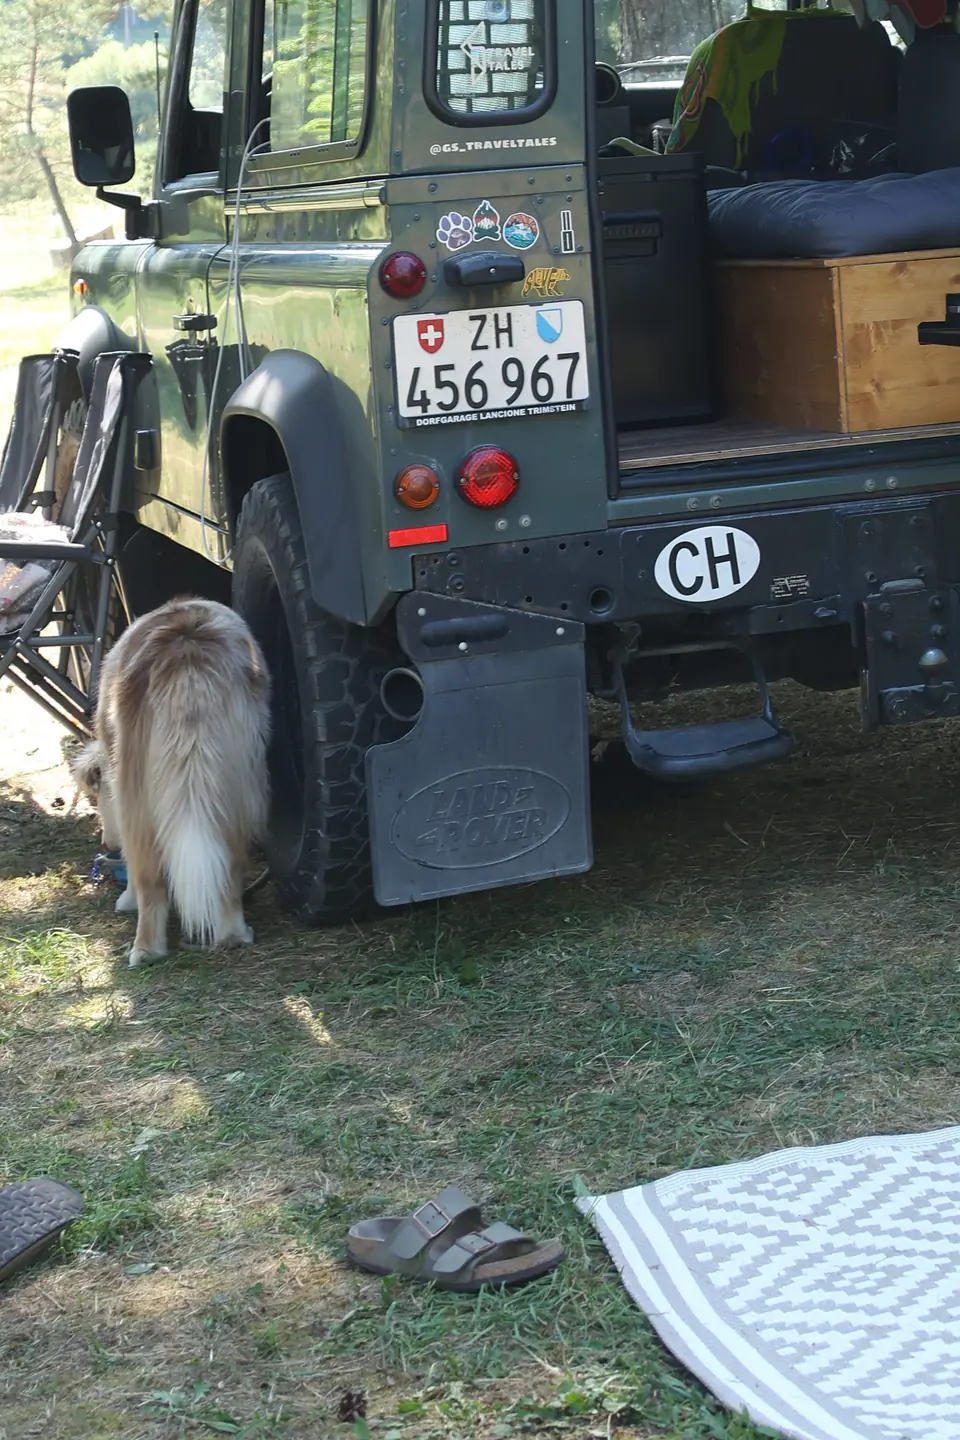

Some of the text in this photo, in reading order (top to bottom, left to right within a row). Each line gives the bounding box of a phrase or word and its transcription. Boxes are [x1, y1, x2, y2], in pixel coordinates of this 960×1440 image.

[486, 46, 535, 58] TRAVEL
[488, 61, 524, 71] TALES
[430, 136, 557, 155] @GS_TRAVELTALES
[469, 312, 514, 351] ZH
[406, 352, 580, 413] 456 967
[416, 403, 576, 426] DORFGARAGE LANCIONE TRIMSTEIN
[668, 532, 741, 596] CH
[436, 807, 547, 854] ROVER
